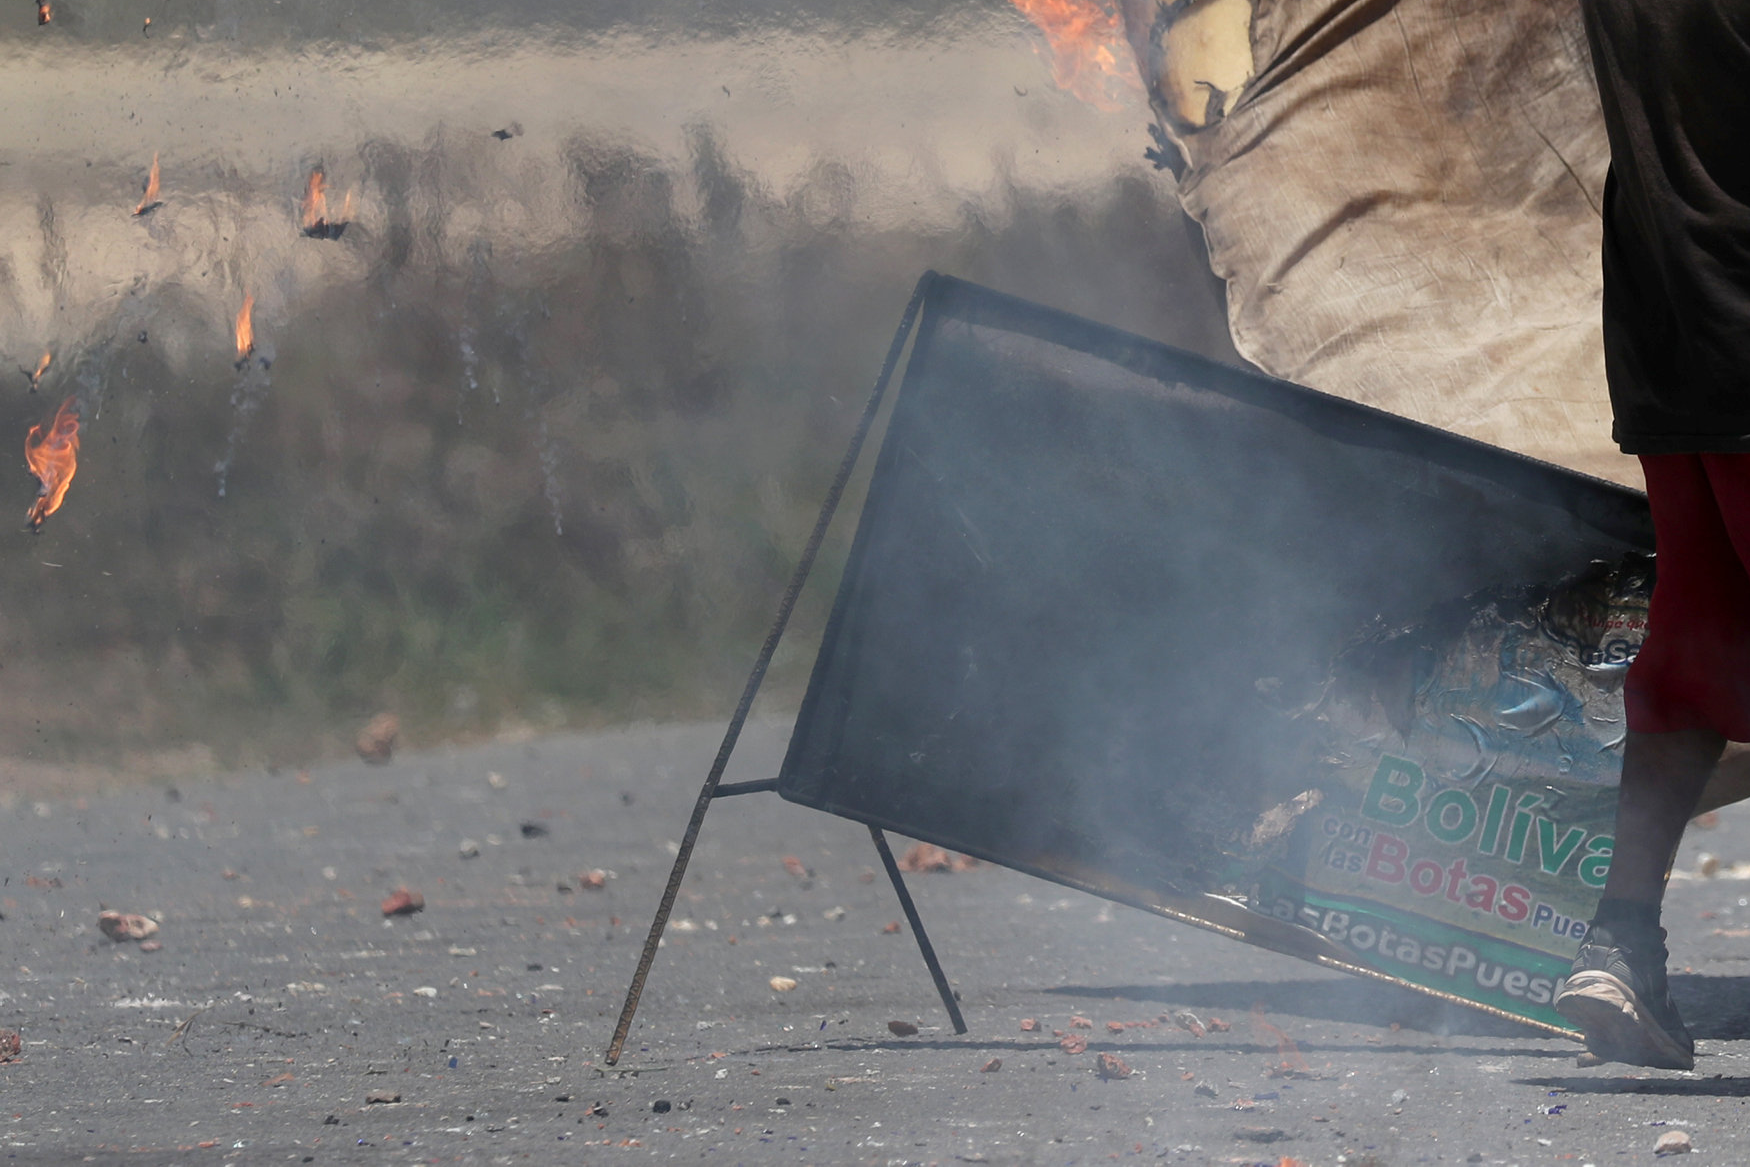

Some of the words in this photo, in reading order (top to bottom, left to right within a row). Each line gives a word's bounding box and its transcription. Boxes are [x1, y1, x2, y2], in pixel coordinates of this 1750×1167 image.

[1322, 816, 1373, 848] con
[1322, 839, 1365, 873] las
[1364, 832, 1532, 924] Botas
